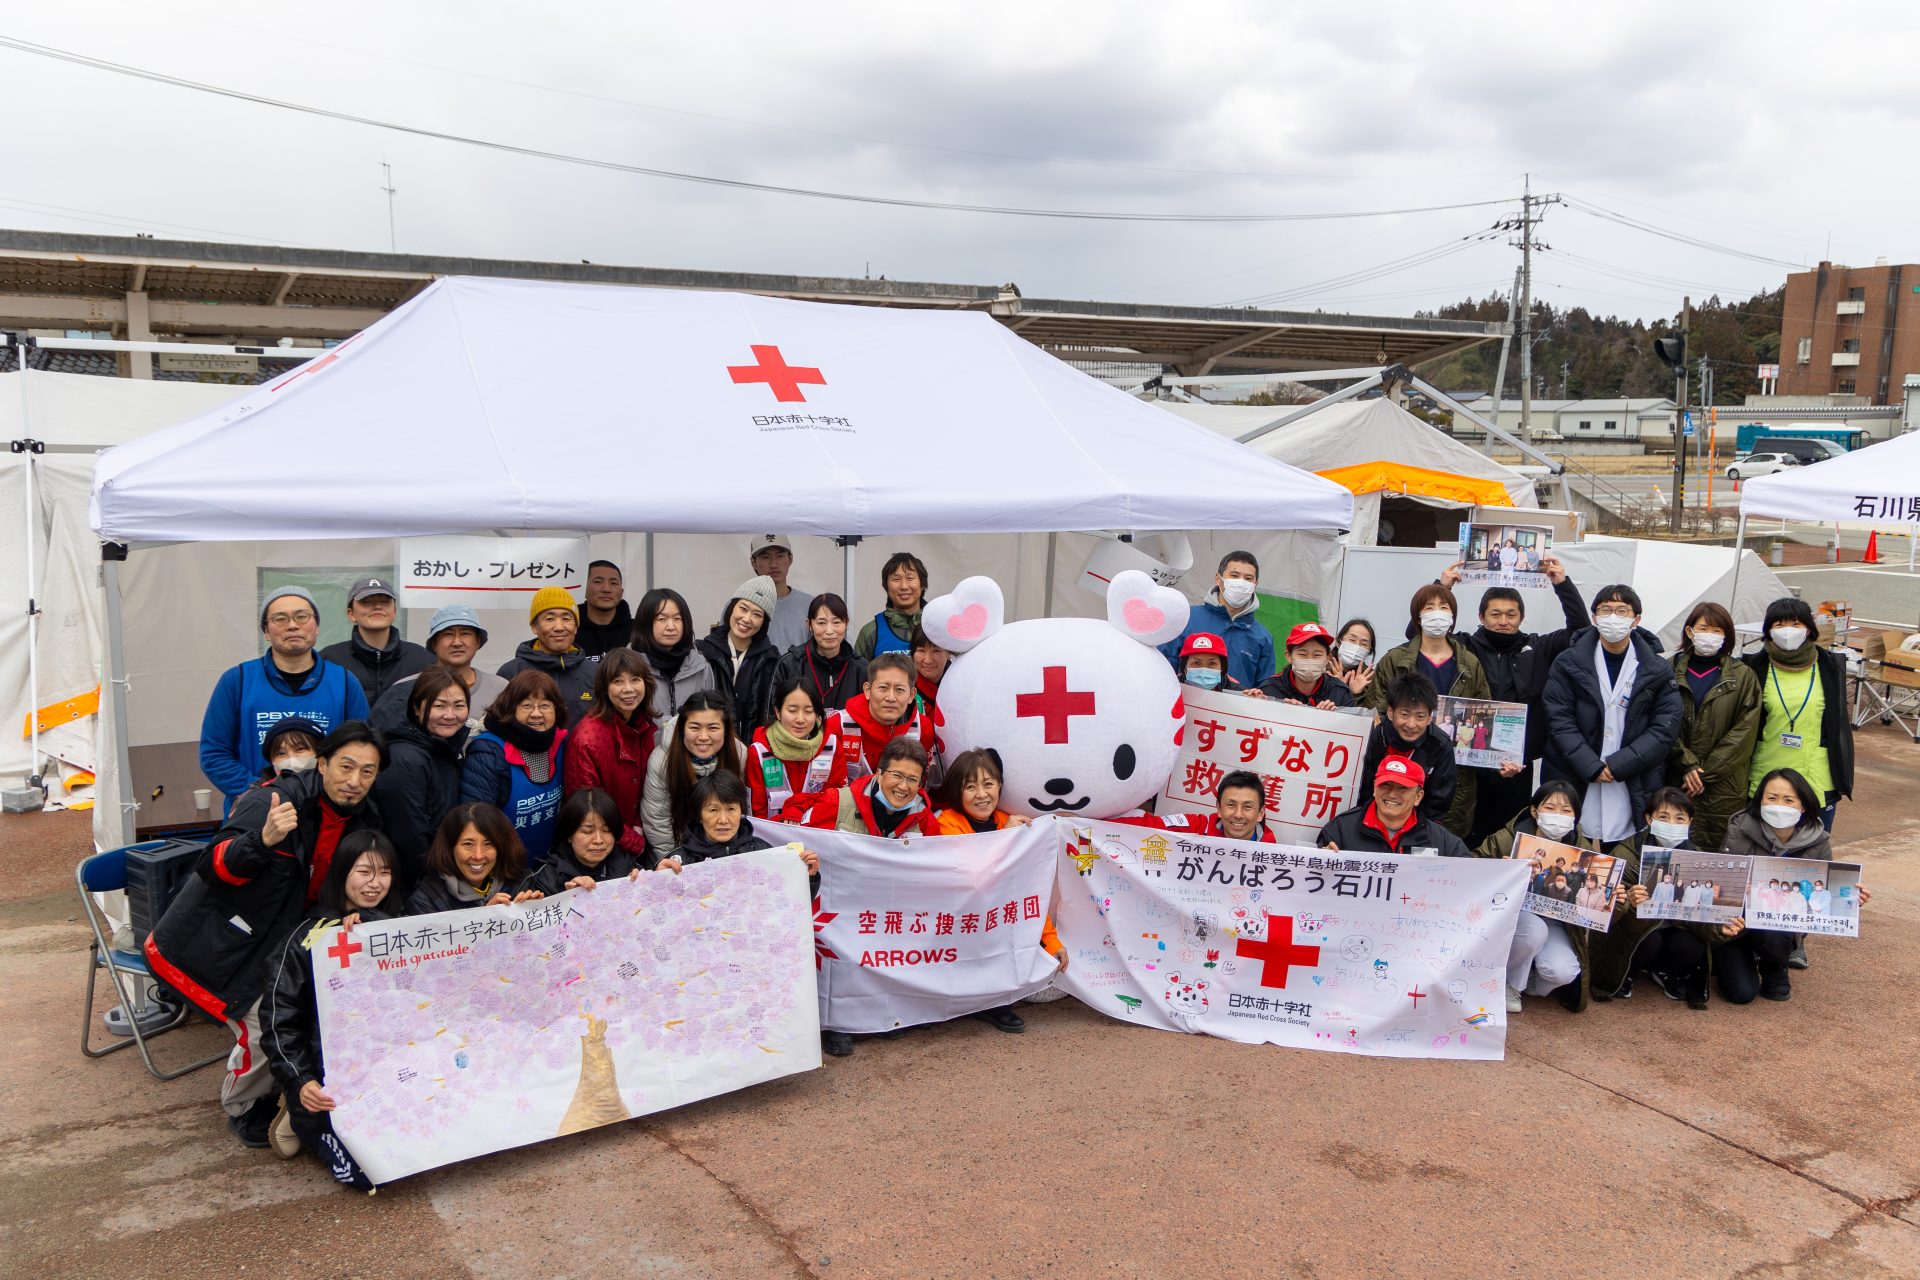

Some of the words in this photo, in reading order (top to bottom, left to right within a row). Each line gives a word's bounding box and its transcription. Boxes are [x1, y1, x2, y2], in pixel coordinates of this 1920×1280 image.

[752, 415, 852, 427] 日本赤十字社
[831, 426, 856, 434] Society
[413, 560, 576, 580] おかし・プレゼント
[369, 579, 382, 587] A
[257, 712, 296, 721] PBV
[1194, 719, 1349, 778] すずなり
[517, 792, 546, 808] PBV
[515, 806, 560, 829] 災害支
[1176, 839, 1247, 860] 令和6年
[1251, 852, 1399, 874] 能登半島地震災害
[1177, 856, 1393, 902] がんばろう石川
[858, 895, 1041, 936] 空飛ぶ捜索医療団
[369, 901, 585, 958] 日本赤十字社の皆様へ
[377, 955, 408, 971] With
[410, 944, 470, 972] gratitude
[860, 947, 958, 968] ARROWS
[1228, 993, 1312, 1018] 日本赤十字社
[1228, 1009, 1256, 1019] Japanese
[1257, 1013, 1269, 1021] Red
[1270, 1014, 1287, 1024] Cross
[1288, 1017, 1310, 1028] Society
